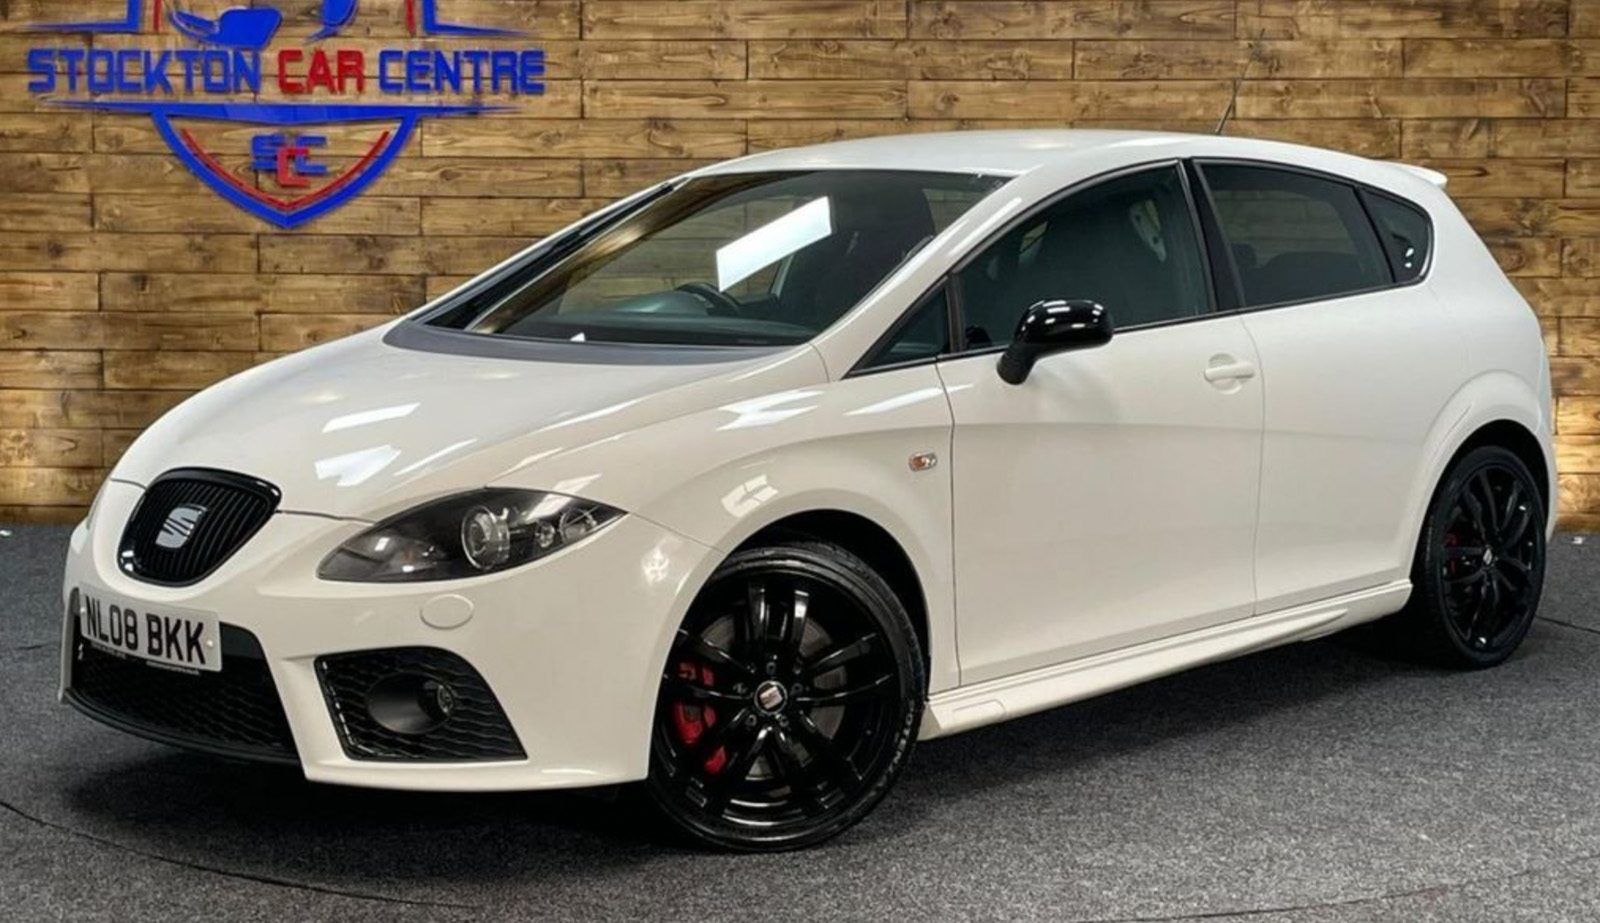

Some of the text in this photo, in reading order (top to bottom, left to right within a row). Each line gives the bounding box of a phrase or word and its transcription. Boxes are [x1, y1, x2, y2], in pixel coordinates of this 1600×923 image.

[28, 49, 545, 94] STOCKTON CAR CENTRE
[85, 595, 206, 665] NL08 BKK
